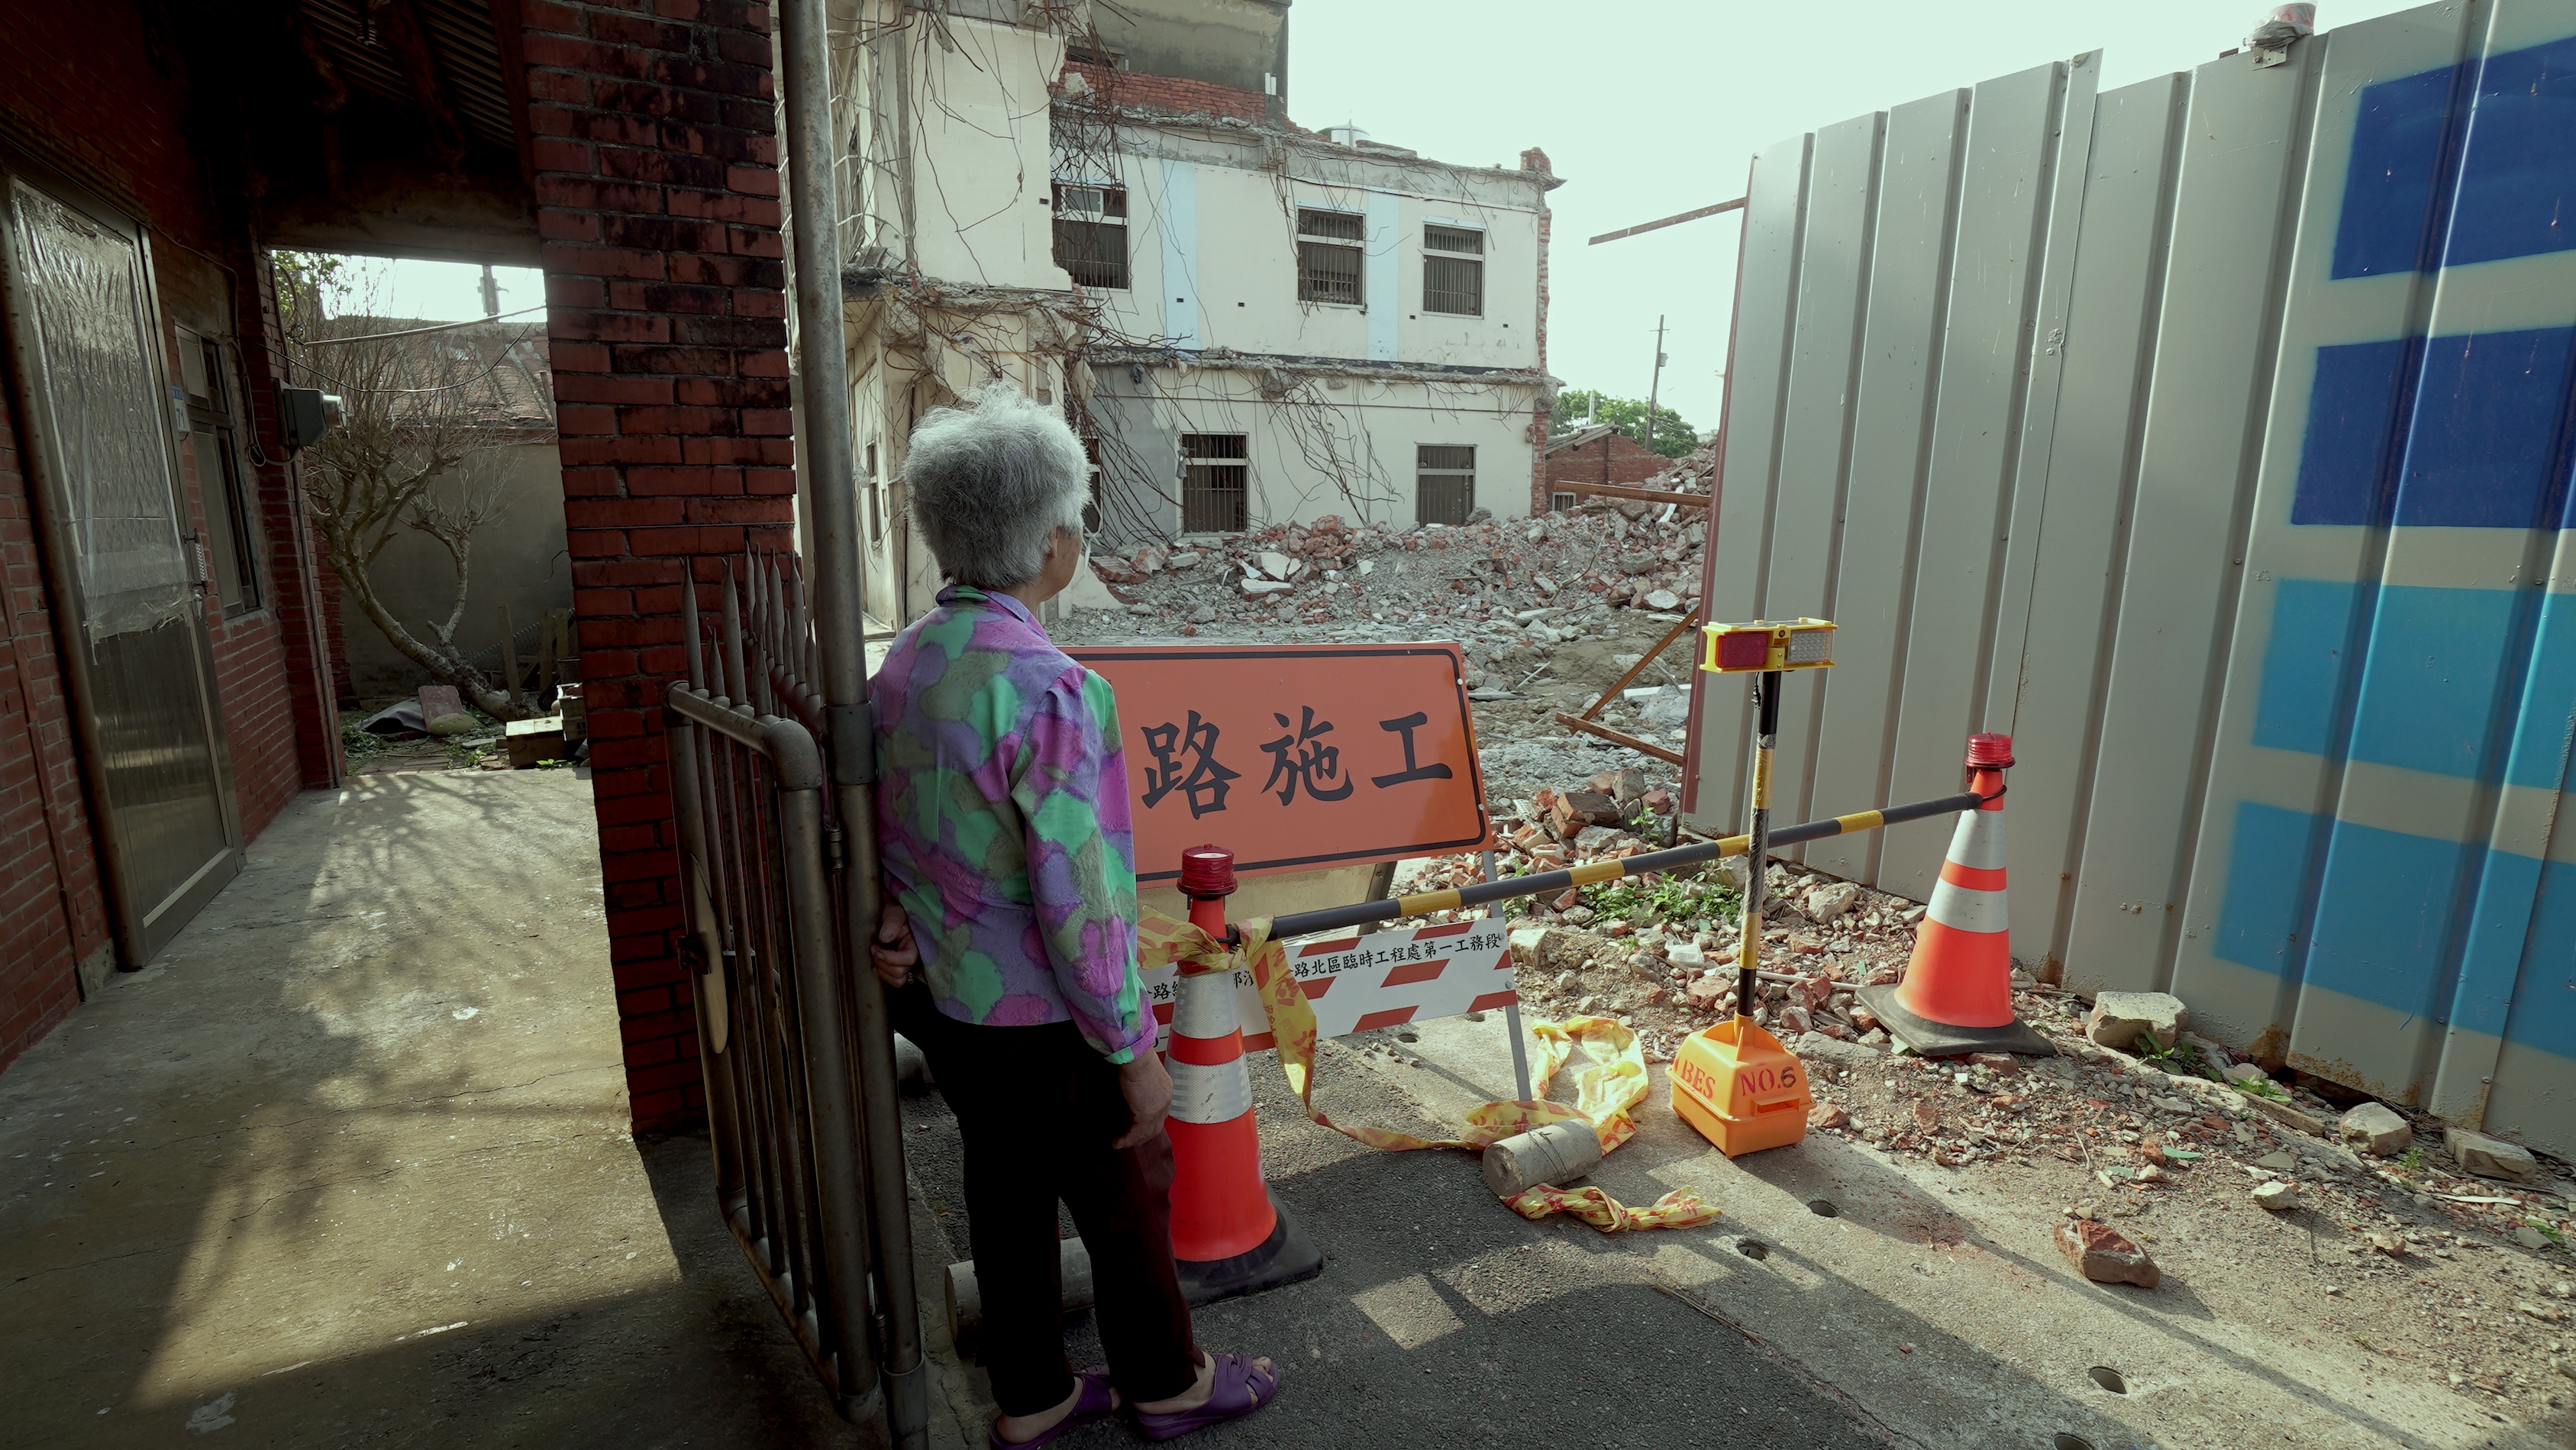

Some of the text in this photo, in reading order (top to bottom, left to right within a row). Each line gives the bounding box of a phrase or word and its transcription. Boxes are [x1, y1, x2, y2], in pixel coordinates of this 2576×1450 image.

[1141, 706, 1453, 820] 路施工
[1290, 933, 1501, 978] 路北區臨時工程處第一工務段
[1680, 1060, 1716, 1098] BES
